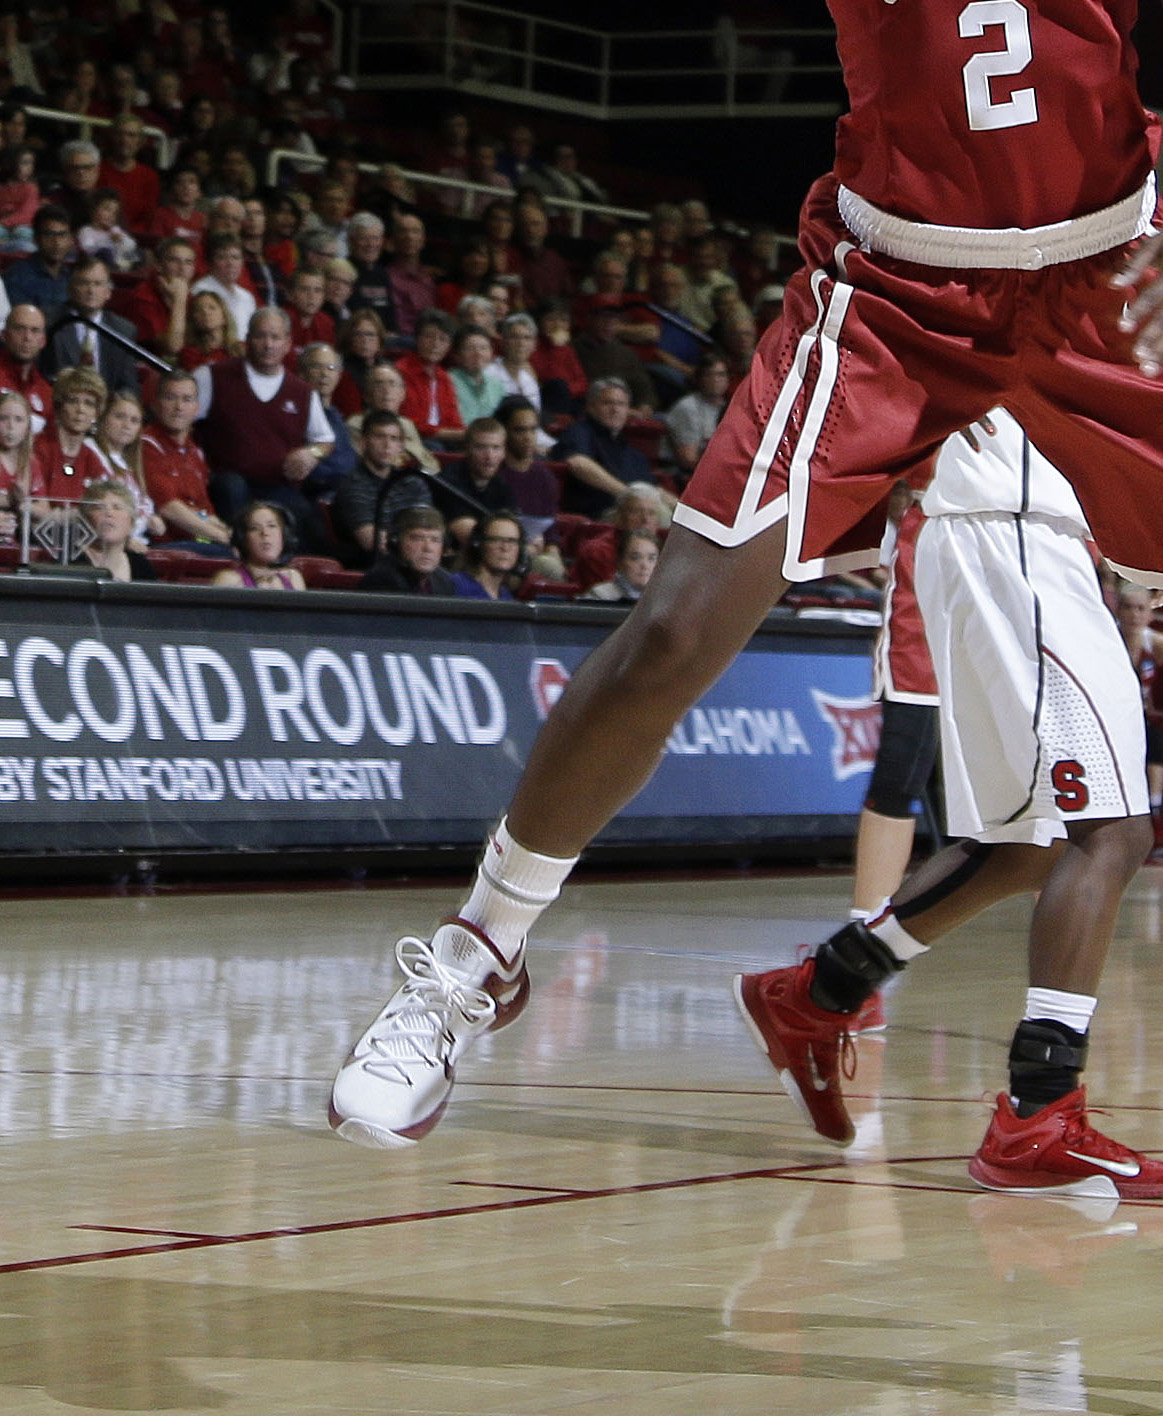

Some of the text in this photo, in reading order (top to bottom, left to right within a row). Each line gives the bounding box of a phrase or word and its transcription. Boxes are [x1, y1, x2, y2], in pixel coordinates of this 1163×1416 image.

[250, 647, 507, 746] ROUND
[664, 707, 813, 755] LAHOMA
[40, 756, 228, 802] STANFORD
[224, 757, 404, 801] UNIVERSITY
[1050, 759, 1090, 813] S
